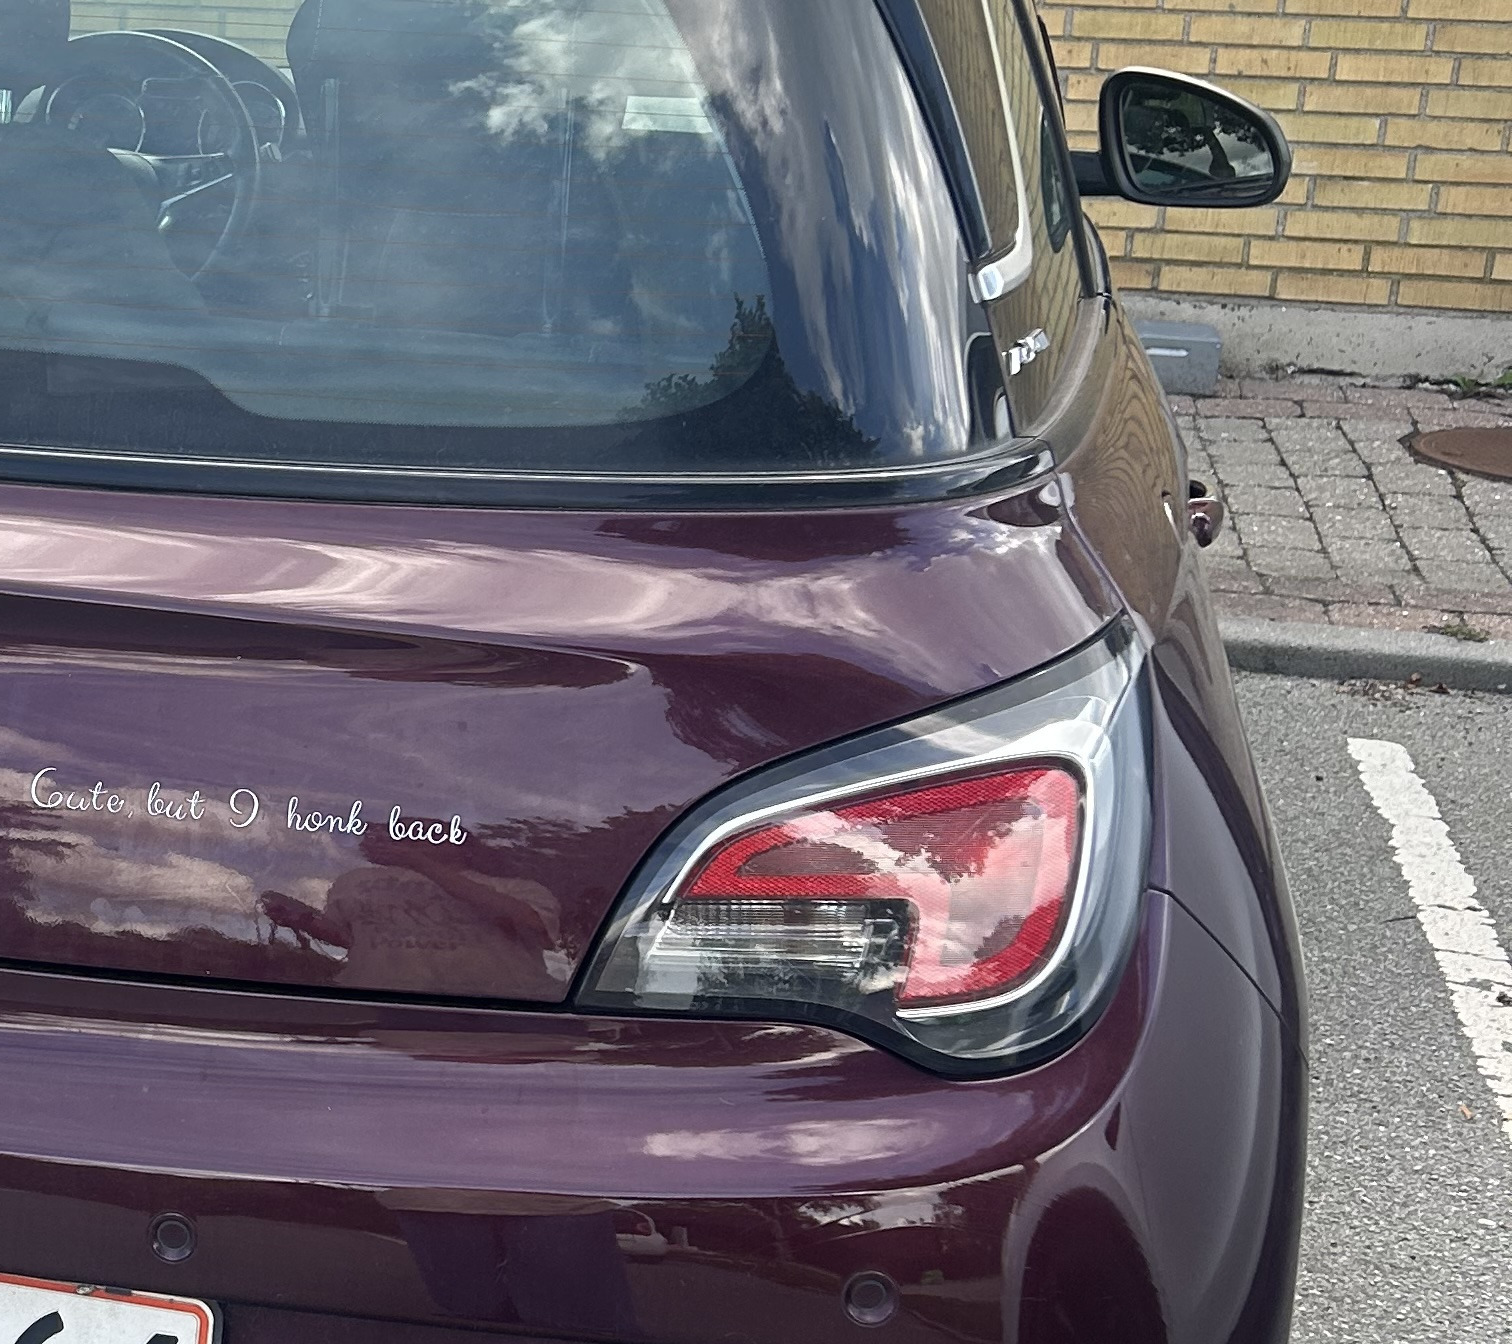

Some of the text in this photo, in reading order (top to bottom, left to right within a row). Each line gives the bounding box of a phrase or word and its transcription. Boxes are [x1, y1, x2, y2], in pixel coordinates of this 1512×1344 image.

[31, 766, 468, 846] Cute, but I honk back
